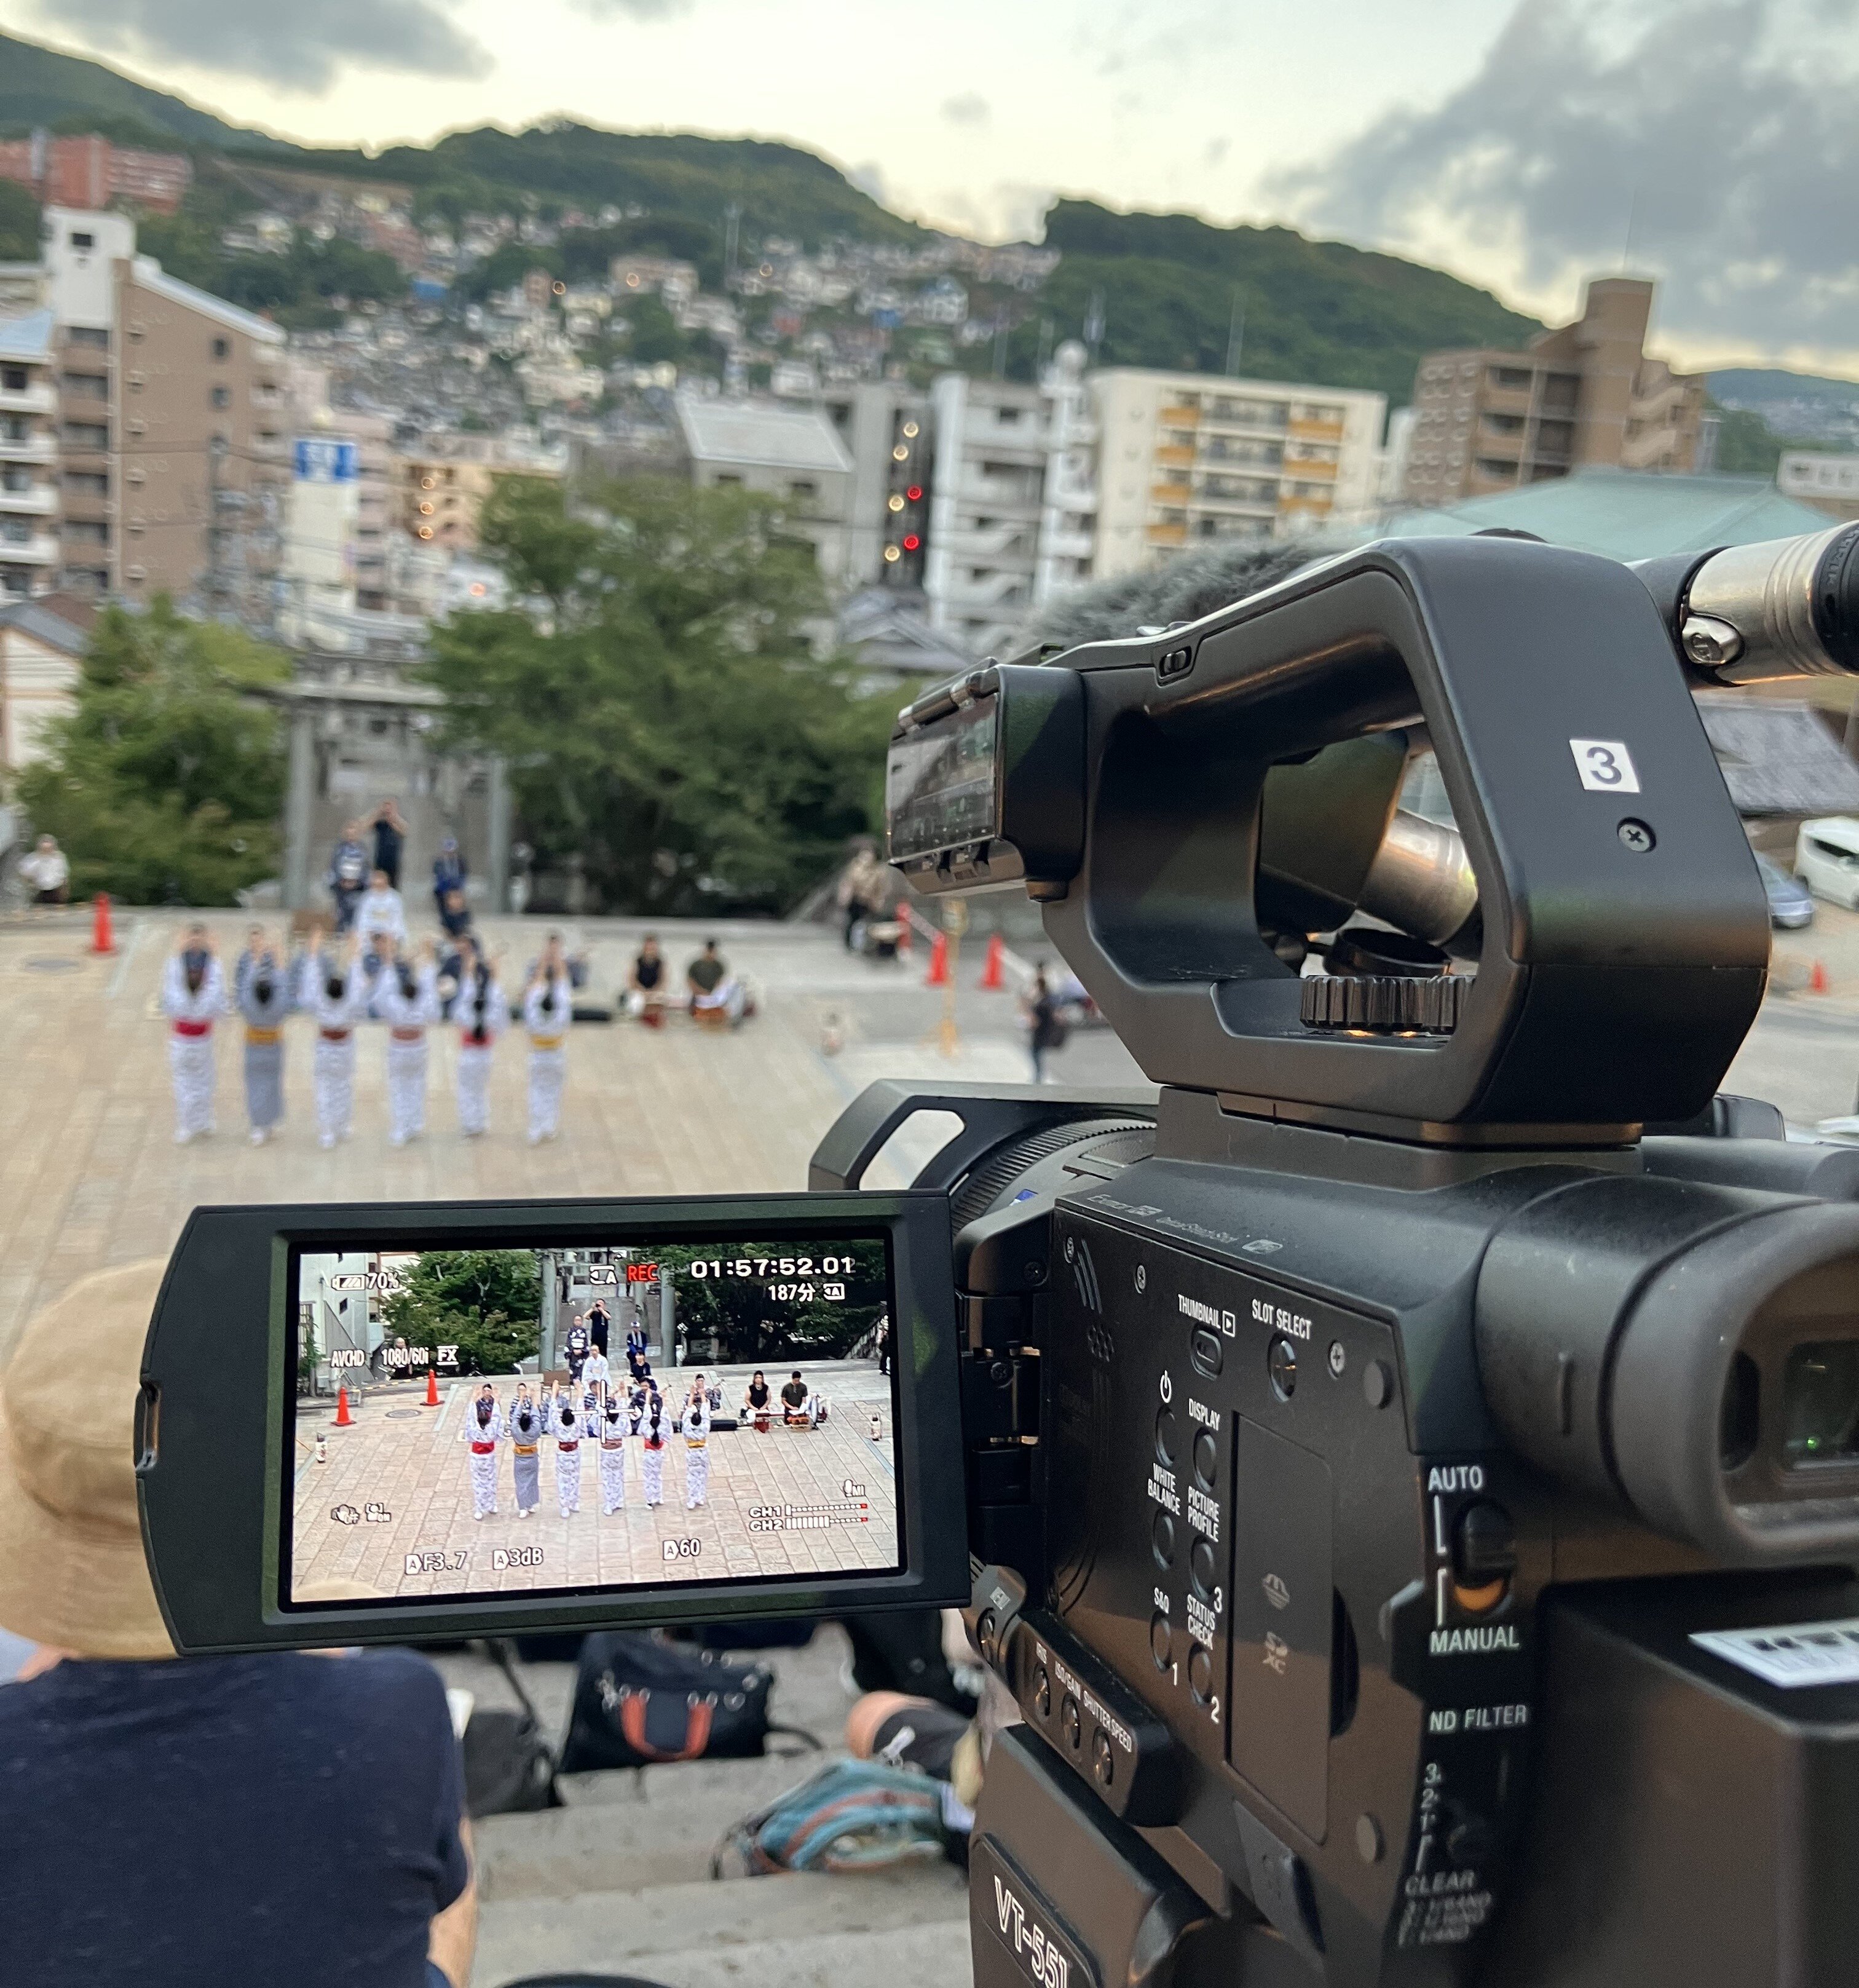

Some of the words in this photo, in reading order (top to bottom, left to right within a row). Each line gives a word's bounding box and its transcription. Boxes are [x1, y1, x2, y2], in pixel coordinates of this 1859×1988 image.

[1586, 746, 1622, 785] 3
[366, 1272, 400, 1290] 70%
[627, 1264, 660, 1282] REC
[768, 1283, 816, 1302] 187分
[1177, 1293, 1222, 1329] THUMBNAIL
[1251, 1298, 1274, 1325] SLOT
[1276, 1308, 1312, 1341] SELECT
[381, 1347, 430, 1366] 1080/60i
[436, 1347, 459, 1364] FX
[1188, 1398, 1221, 1432] DISPLAY
[1153, 1462, 1177, 1494] WHITE
[1427, 1465, 1484, 1492] AUTO
[749, 1505, 782, 1518] CH1
[1147, 1478, 1181, 1516] BALANCE
[1187, 1485, 1220, 1523] PICTURE
[749, 1518, 784, 1532] CH2
[1187, 1505, 1219, 1543] PROFILE
[1186, 1593, 1216, 1631] STATUS
[1214, 1586, 1223, 1614] 3
[1187, 1613, 1214, 1650] CHECK
[1429, 1626, 1520, 1656] MANUAL
[1172, 1661, 1178, 1687] 1
[1083, 1690, 1111, 1732] SHUTTER
[1111, 1719, 1133, 1754] SPEED
[1210, 1695, 1220, 1724] 2
[1428, 1710, 1457, 1733] ND
[1464, 1703, 1527, 1730] FILTER
[1405, 1869, 1475, 1895] CLEAR
